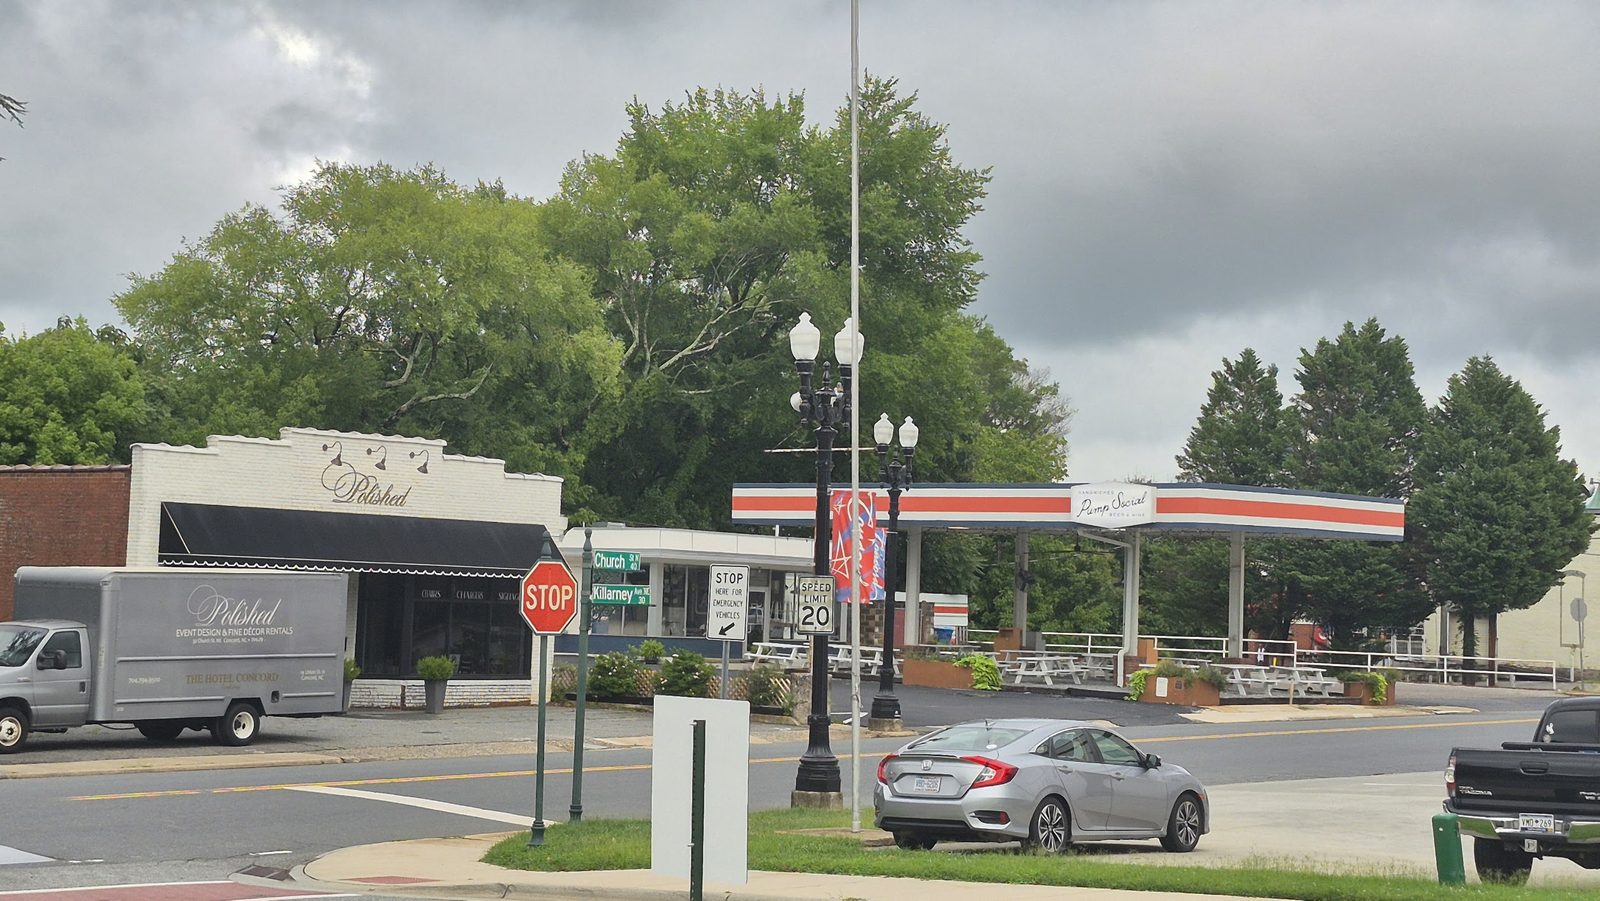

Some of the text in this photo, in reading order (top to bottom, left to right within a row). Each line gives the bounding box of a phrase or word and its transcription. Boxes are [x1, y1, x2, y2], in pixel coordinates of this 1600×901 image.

[321, 461, 412, 507] Polished
[1076, 491, 1148, 518] Pump Social
[594, 552, 625, 569] Church
[629, 553, 634, 562] St
[630, 562, 638, 570] 40
[716, 572, 744, 584] STOP
[715, 587, 743, 596] HERE FOR
[801, 583, 831, 592] SPEED
[421, 589, 441, 599] CHAIRS
[456, 590, 484, 600] CHARGERS
[526, 584, 573, 611] STOP
[593, 586, 650, 604] Killarney Ave NE
[638, 596, 646, 604] 30
[804, 594, 828, 604] LIMIT
[187, 584, 282, 627] Polished
[713, 599, 743, 608] EMERGENCY
[715, 610, 740, 620] VEHICLES
[801, 605, 830, 626] 20
[175, 626, 294, 638] EVENT DESIGN & FINE DÉCOR RENTALS
[185, 671, 279, 684] THE HOTEL CONCORD
[1539, 819, 1552, 829] 269
